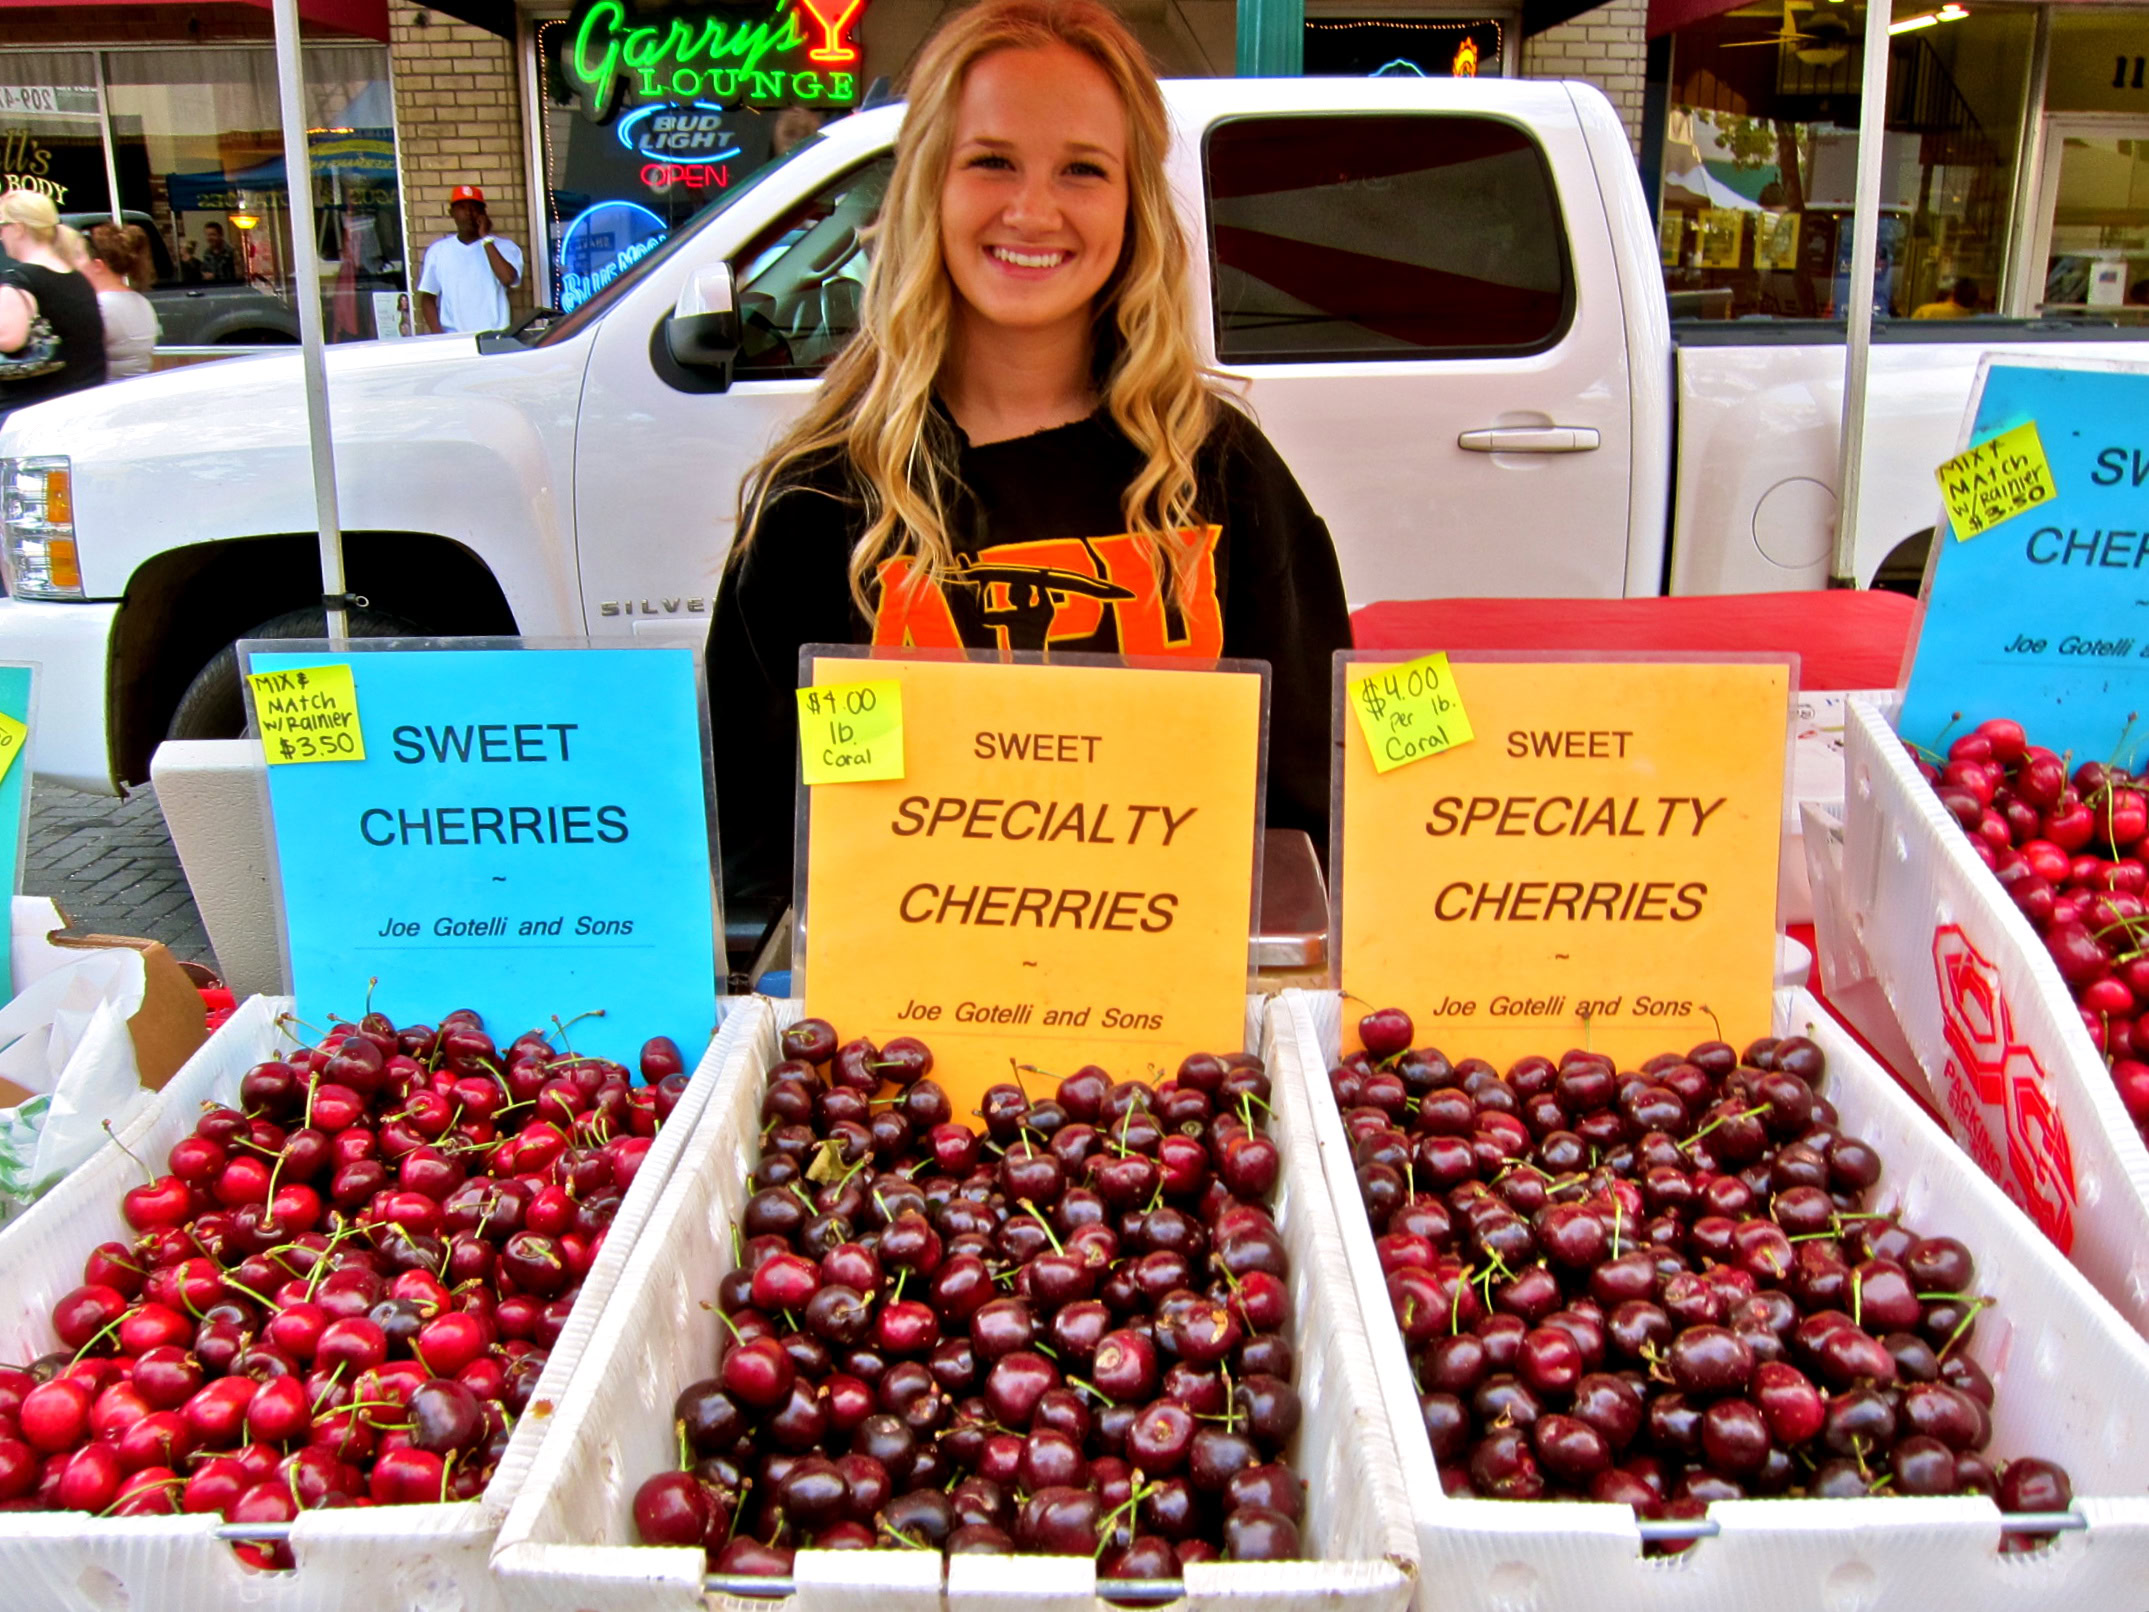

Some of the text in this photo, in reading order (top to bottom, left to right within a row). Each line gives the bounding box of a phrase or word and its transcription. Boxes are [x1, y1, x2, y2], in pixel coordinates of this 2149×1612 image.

[574, 0, 808, 110] Garry's
[638, 67, 854, 100] LOUNGE
[652, 115, 722, 132] BUD
[639, 131, 735, 149] LIGHT
[4, 174, 69, 206] BODY
[640, 163, 728, 189] OPEN
[1939, 448, 1985, 483] MIX
[1968, 486, 2046, 533] $3.50
[600, 596, 720, 617] SILVE
[2004, 633, 2048, 654] Joe
[2059, 636, 2136, 657] Gotelli
[255, 673, 295, 693] MIX
[1362, 666, 1438, 721] $4.00
[806, 688, 876, 715] $4.00
[280, 732, 355, 760] $3.50
[393, 724, 578, 764] SWEET
[823, 748, 872, 767] Coral
[975, 732, 1102, 762] SWEET
[1386, 726, 1450, 761] Coral
[1508, 731, 1632, 757] SWEET
[361, 806, 628, 846] CHERRIES
[892, 796, 1197, 846] SPECIALTY
[1426, 797, 1726, 836] SPECIALTY
[900, 883, 1178, 932] CHERRIES
[1435, 882, 1707, 921] CHERRIES
[379, 916, 633, 937] Joe Gotelli and Sons
[898, 1000, 1163, 1030] Joe Gotelli and Sons
[1433, 996, 1692, 1016] Joe Gotelli and Sons
[1944, 1058, 2003, 1181] PACKING
